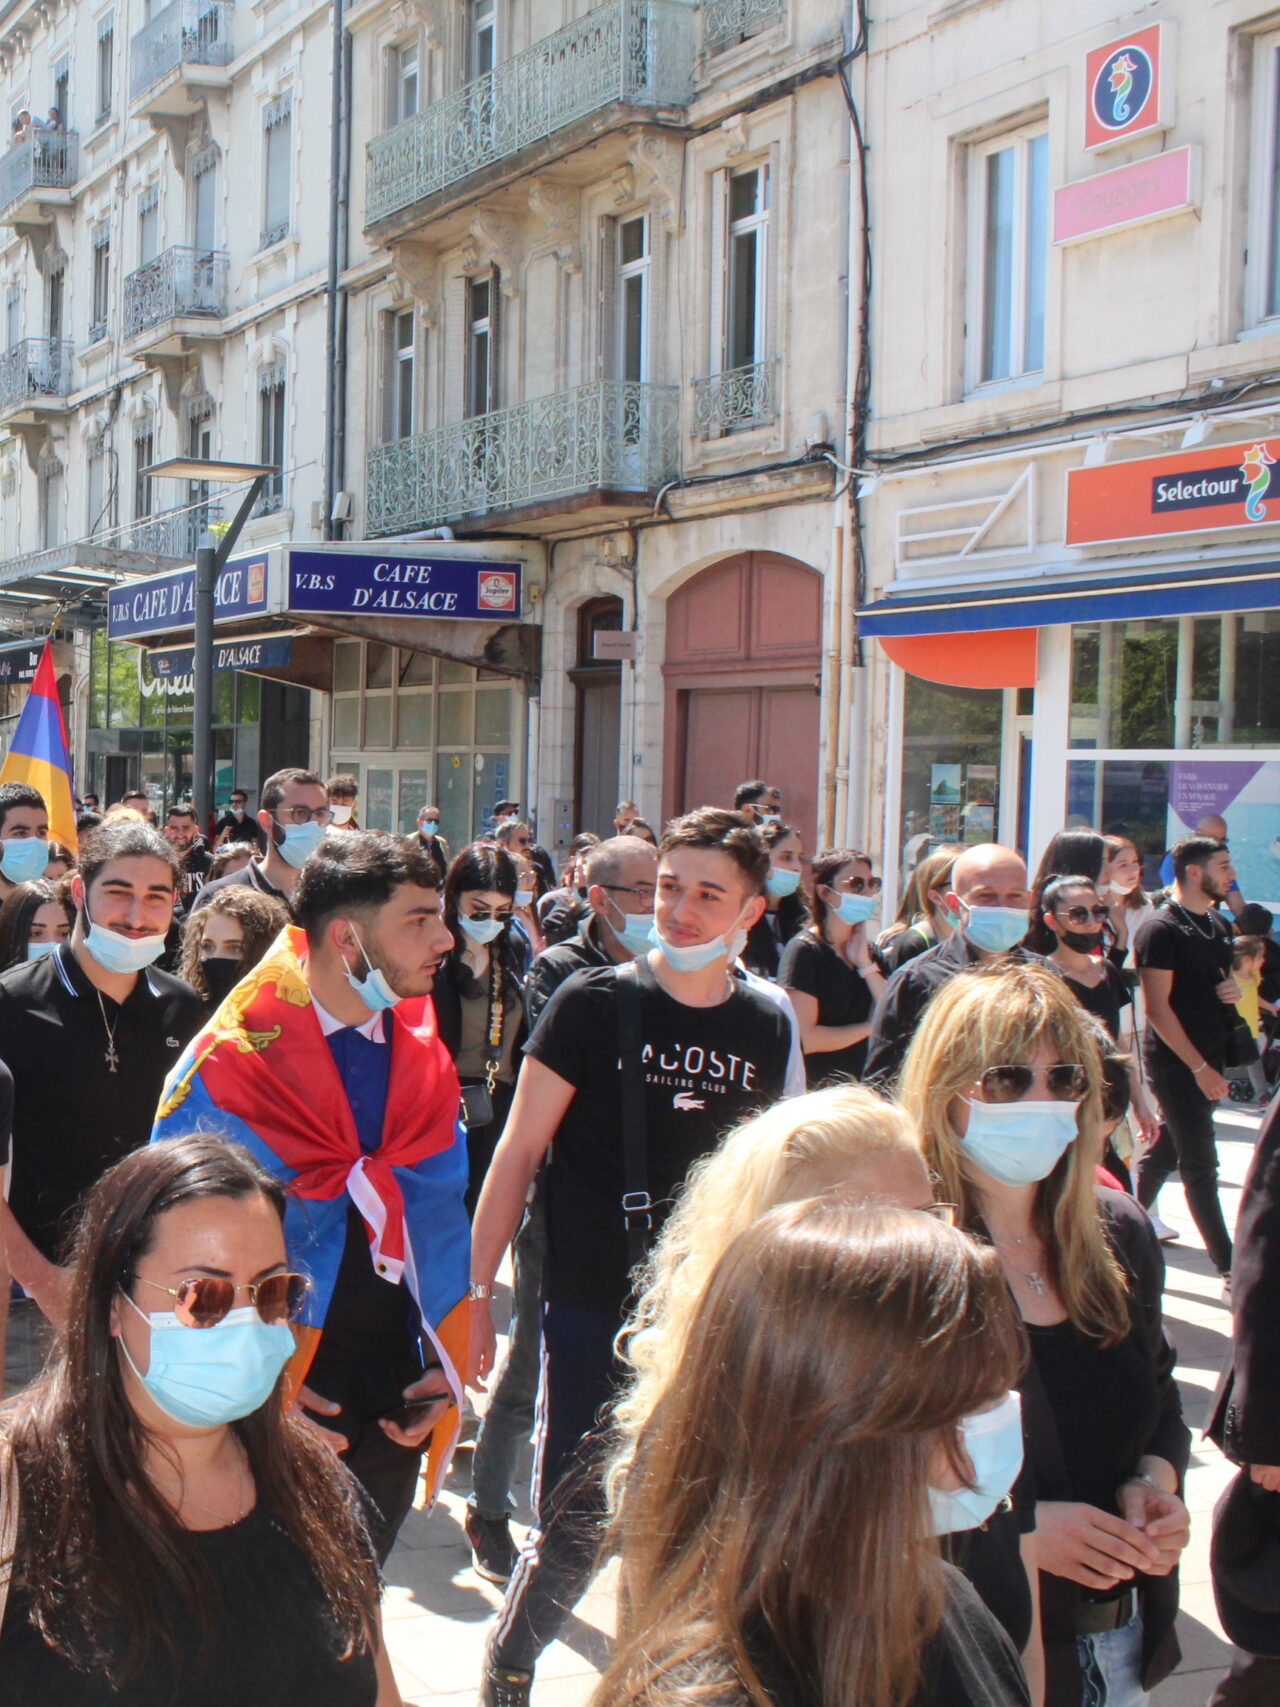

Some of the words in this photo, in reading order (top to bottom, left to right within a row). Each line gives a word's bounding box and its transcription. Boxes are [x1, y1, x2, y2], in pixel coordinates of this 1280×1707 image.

[1079, 176, 1161, 214] Voyages
[1157, 479, 1238, 503] Selectour
[295, 573, 335, 590] V.B.S
[373, 563, 432, 584] CAFE
[133, 587, 168, 622] CAFE
[170, 571, 242, 615] D'AACE
[618, 1043, 756, 1091] ACOSTE
[646, 1073, 694, 1088] SAILING
[701, 1081, 727, 1094] CLUB
